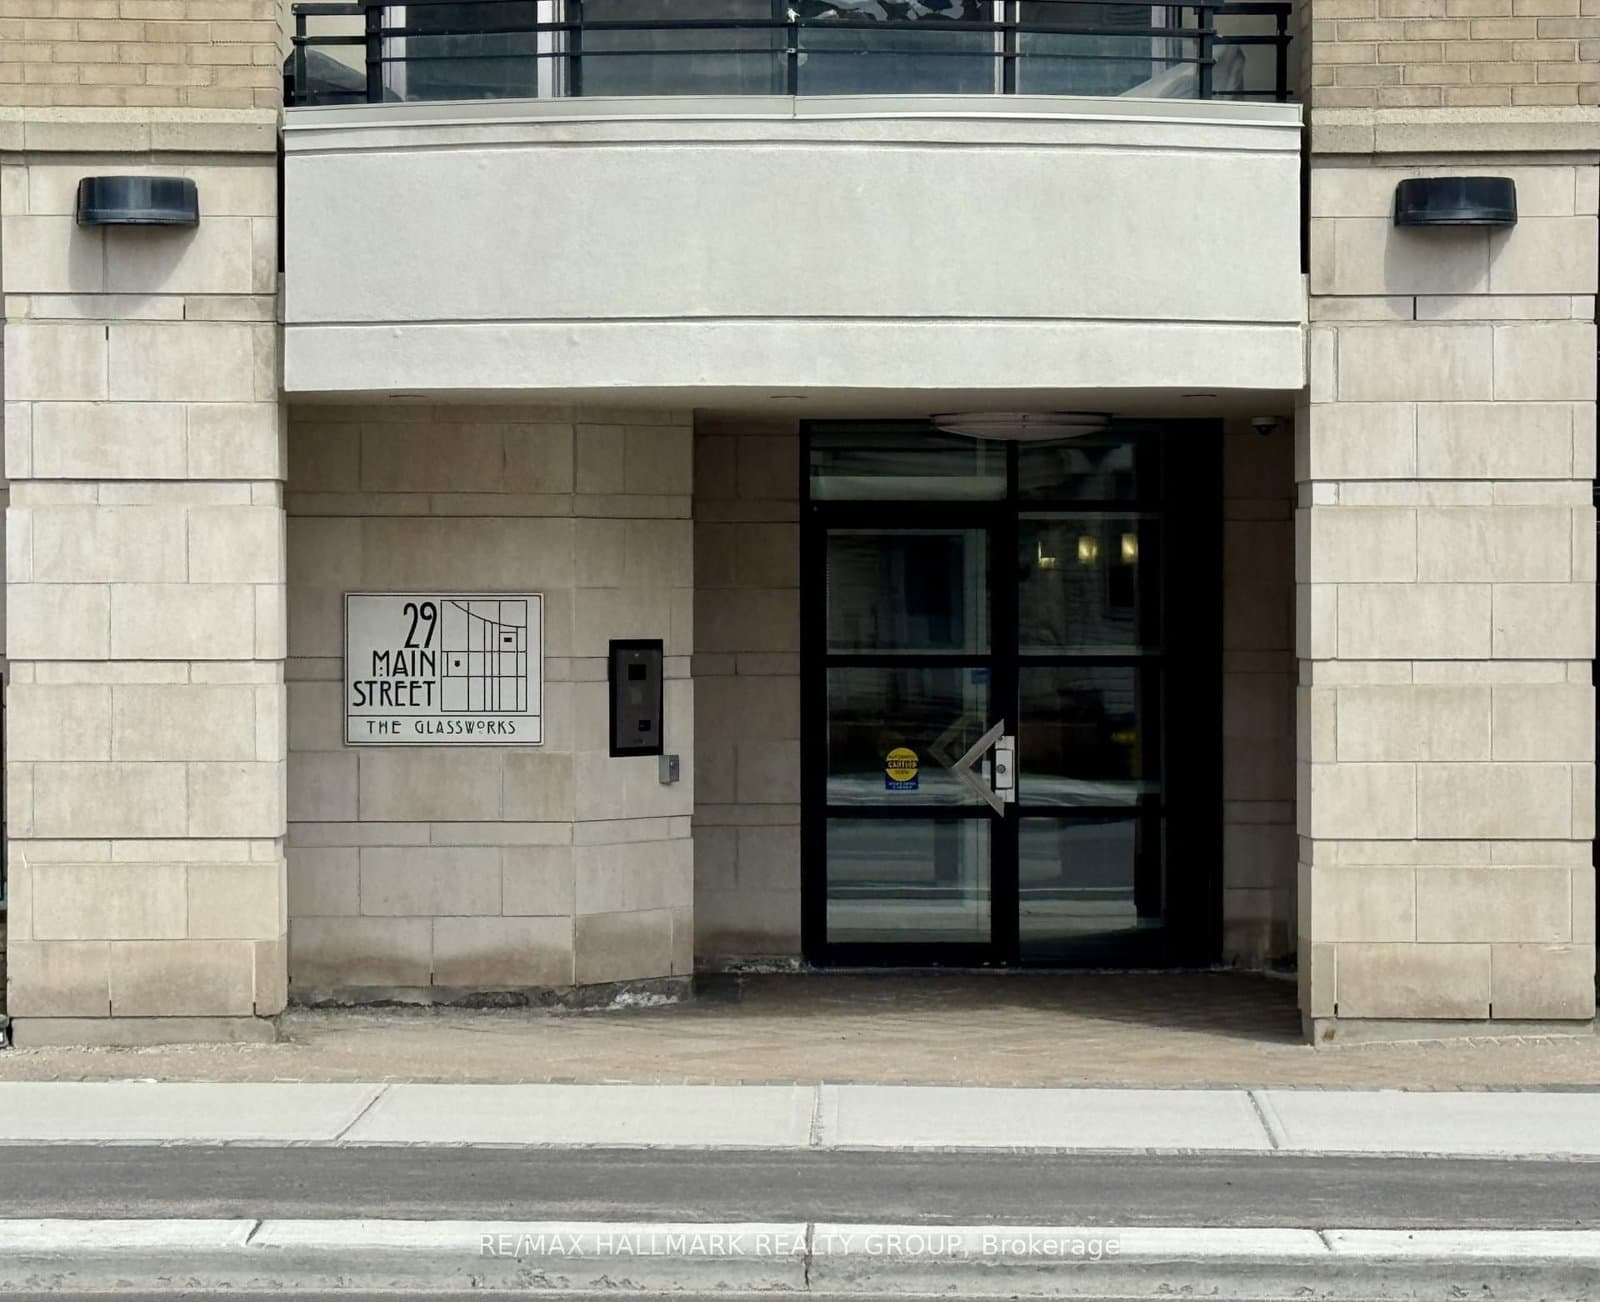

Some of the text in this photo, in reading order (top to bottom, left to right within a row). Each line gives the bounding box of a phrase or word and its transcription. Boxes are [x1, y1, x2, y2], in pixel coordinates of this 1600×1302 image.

[403, 601, 438, 649] 29
[372, 650, 436, 677] MAIN
[352, 680, 436, 707] STREET
[366, 720, 516, 735] THE GLASSWORKS
